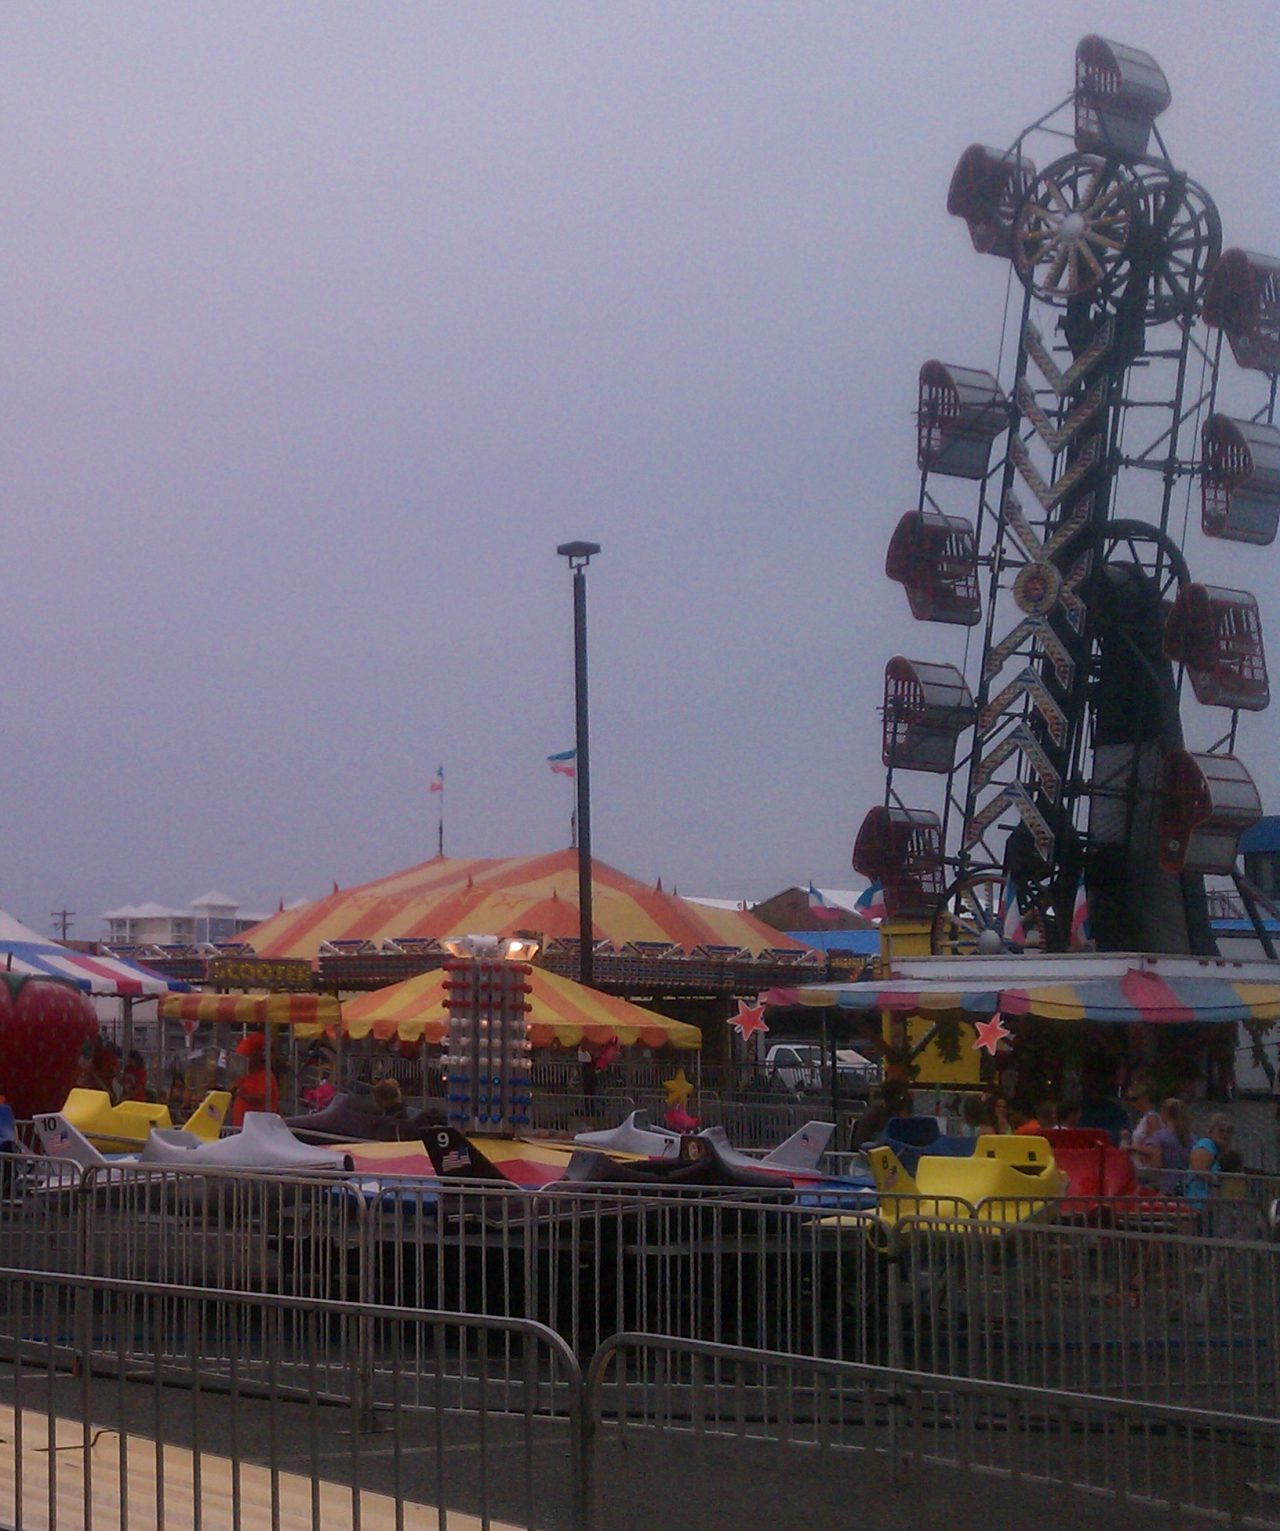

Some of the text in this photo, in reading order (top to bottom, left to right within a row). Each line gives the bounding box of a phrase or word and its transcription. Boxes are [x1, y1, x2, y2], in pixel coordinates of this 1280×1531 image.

[41, 1117, 57, 1132] 10
[437, 1132, 450, 1148] 9
[881, 1154, 889, 1170] 8
